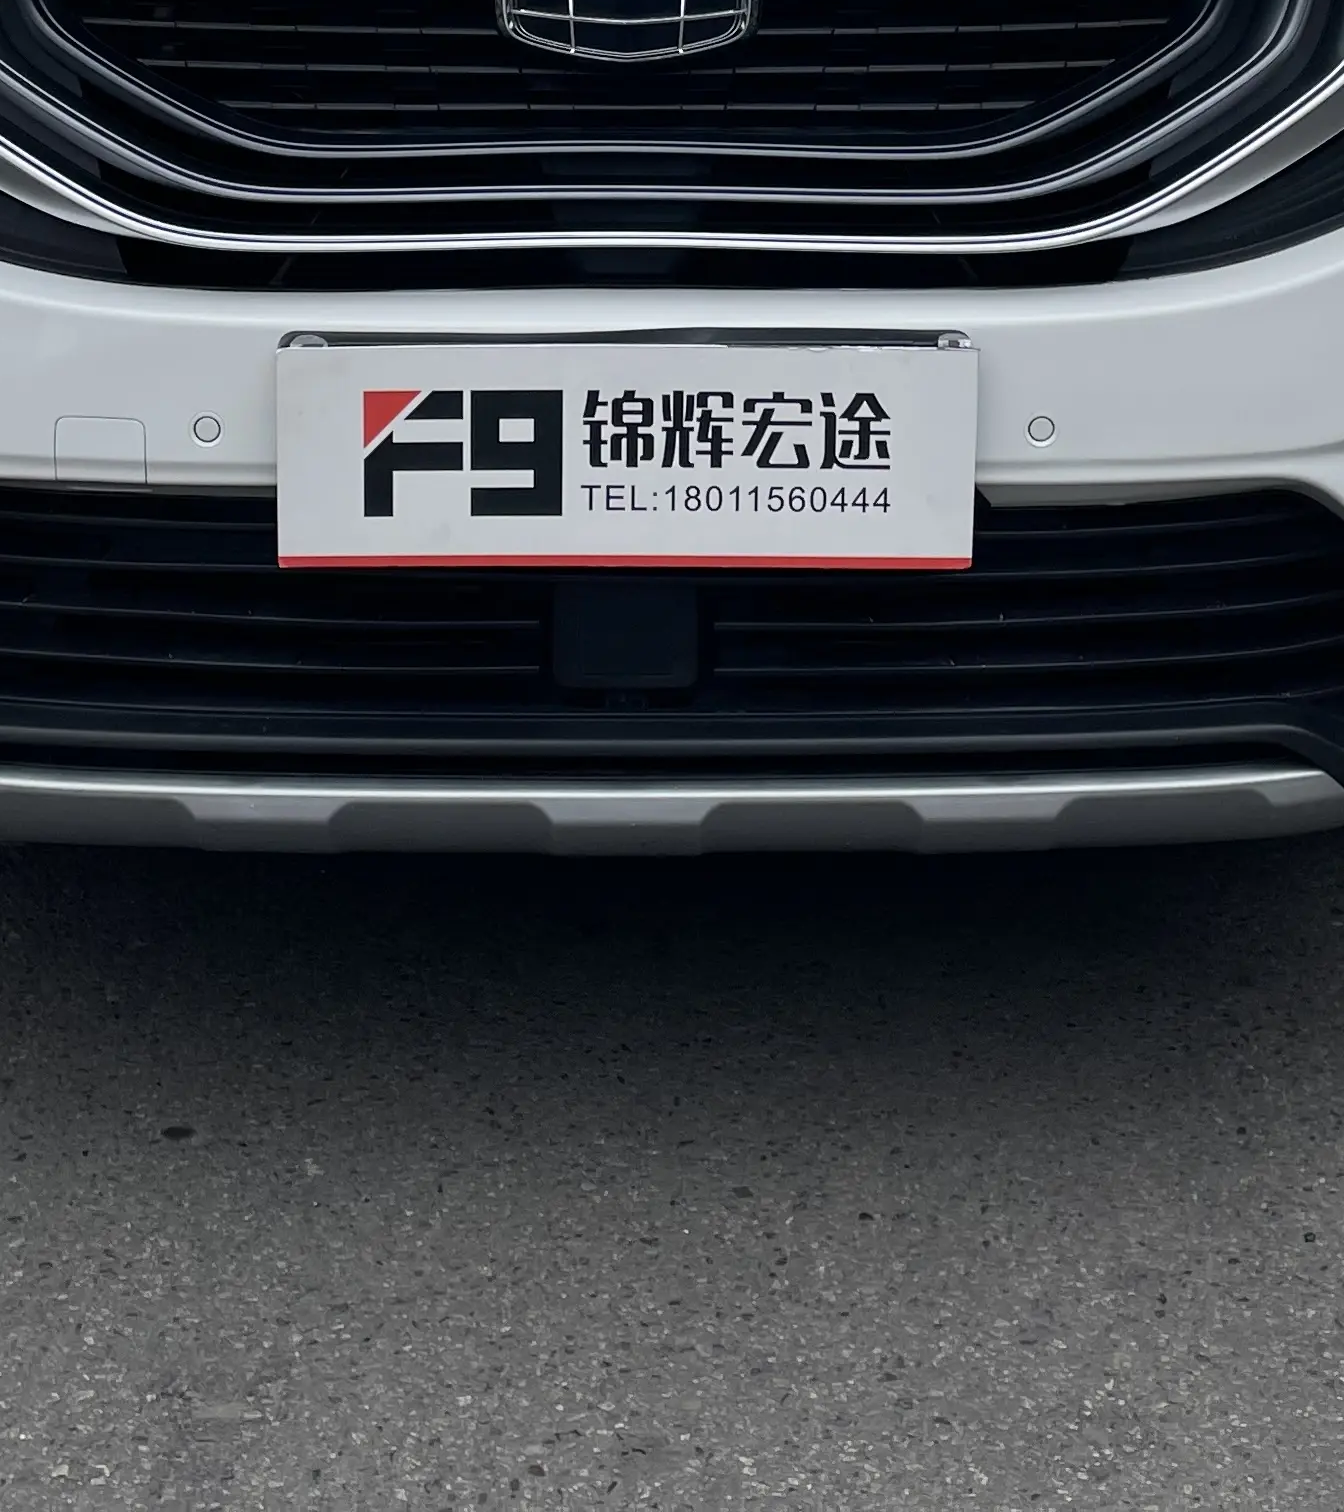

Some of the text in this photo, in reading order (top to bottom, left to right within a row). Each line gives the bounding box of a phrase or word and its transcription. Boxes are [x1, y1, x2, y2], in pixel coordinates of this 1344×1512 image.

[582, 389, 891, 470] 锦辉宏途
[580, 484, 891, 513] TEL:18011560444
